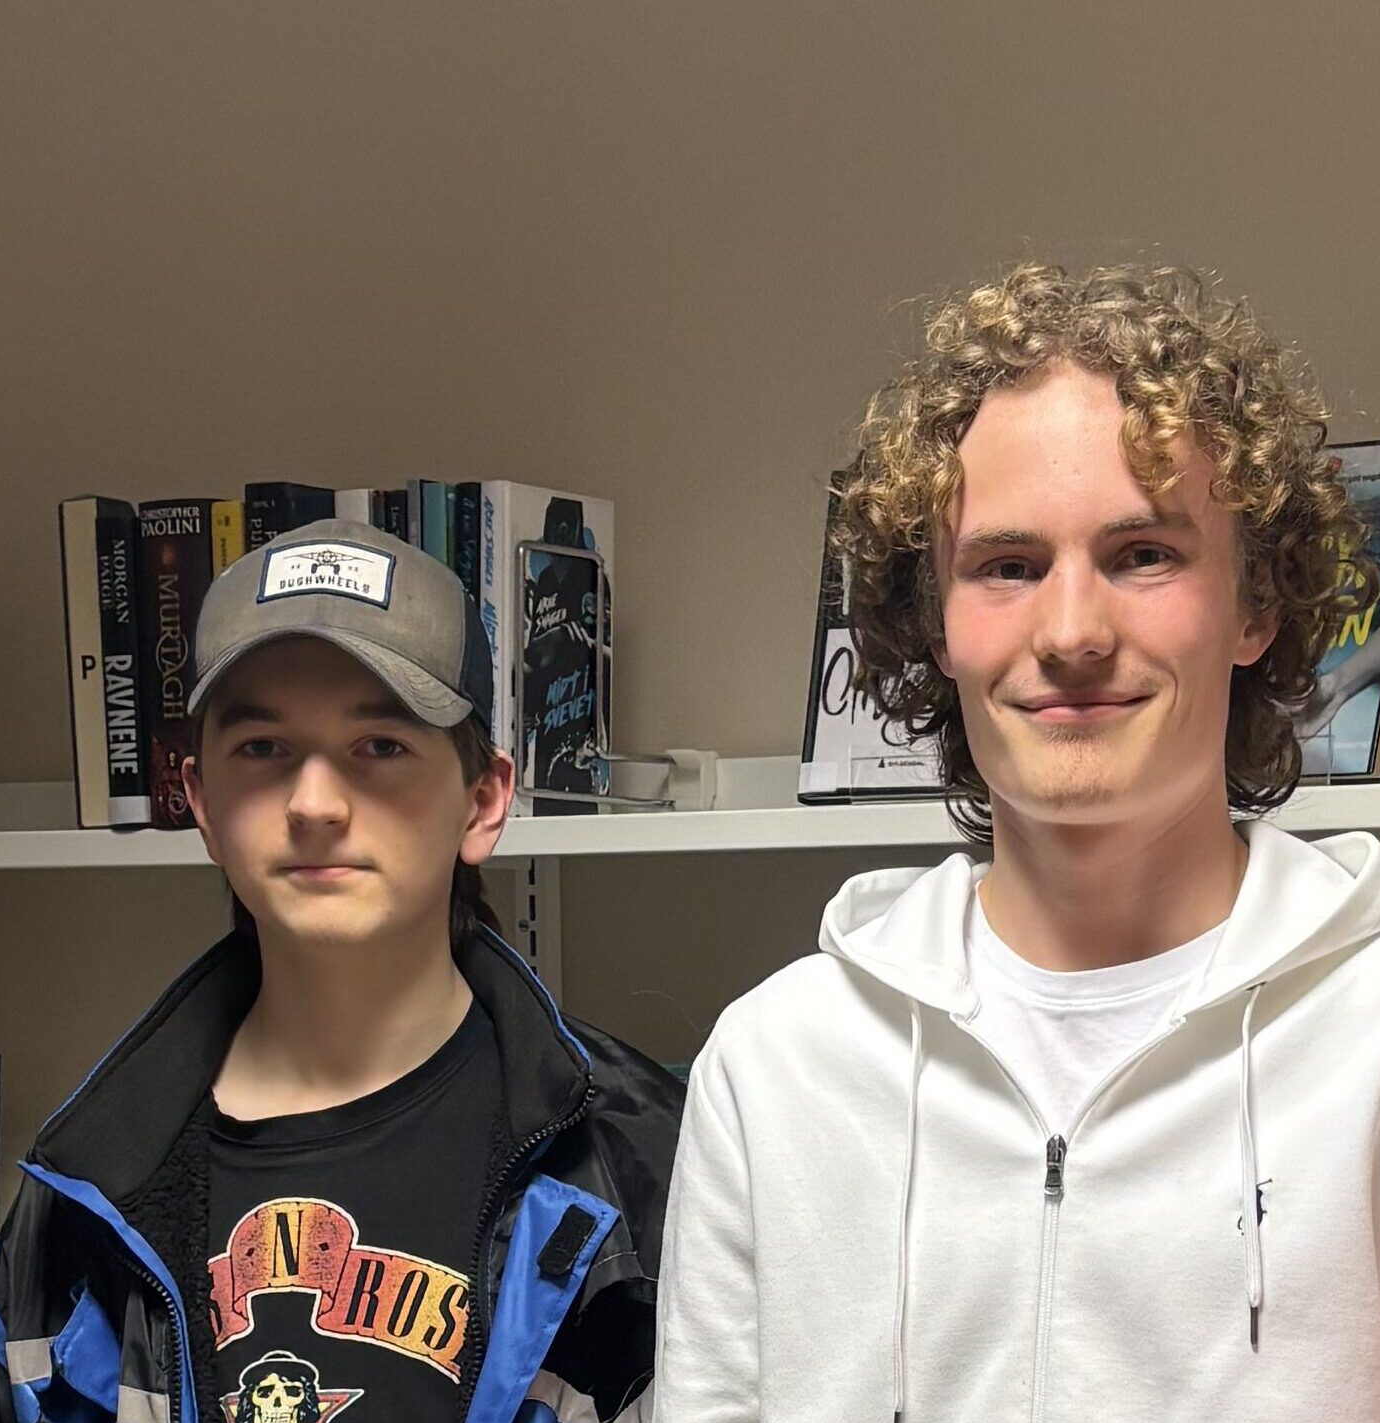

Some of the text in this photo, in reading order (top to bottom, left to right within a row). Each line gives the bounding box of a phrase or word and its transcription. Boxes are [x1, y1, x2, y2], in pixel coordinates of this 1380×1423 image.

[140, 506, 200, 522] CHRISTOPHER
[140, 514, 201, 538] PAOLINI
[100, 554, 112, 611] PAIGE
[111, 539, 130, 624] MORGAN
[81, 654, 97, 680] P
[155, 573, 188, 719] MURTAGH
[104, 653, 139, 776] RAVNENE
[344, 1257, 469, 1351] ROS
